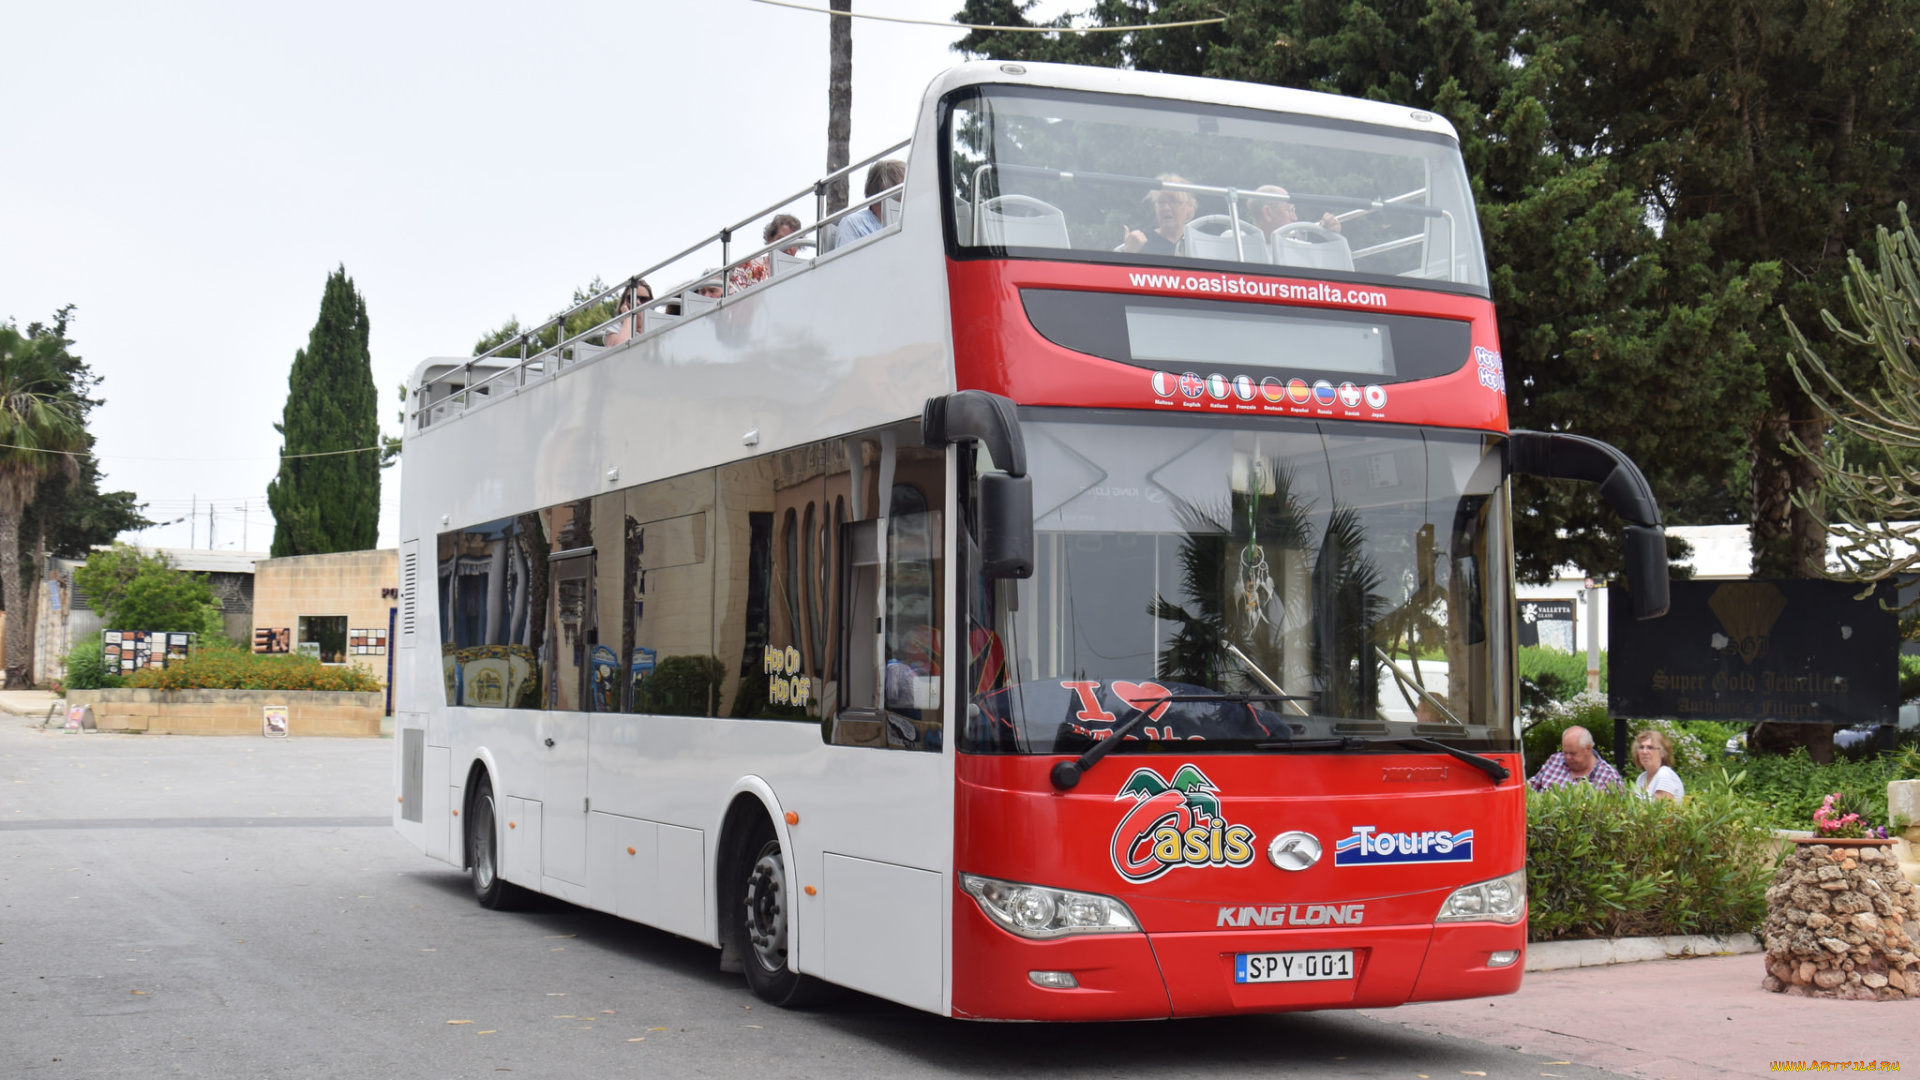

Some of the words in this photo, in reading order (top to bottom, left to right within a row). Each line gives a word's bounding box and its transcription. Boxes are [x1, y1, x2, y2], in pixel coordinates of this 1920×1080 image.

[1129, 273, 1387, 306] www.oasistoursmalta.com
[764, 644, 784, 675] Hop
[785, 645, 801, 676] On
[769, 674, 789, 705] Hop
[790, 675, 811, 707] Off
[1652, 669, 1706, 694] Super
[1712, 670, 1756, 692] Gold
[1110, 787, 1256, 885] Oasis
[1352, 825, 1455, 857] Tours
[1216, 907, 1286, 927] KING
[1287, 904, 1365, 925] LONG
[1250, 956, 1294, 978] SPY
[1306, 955, 1348, 976] 001
